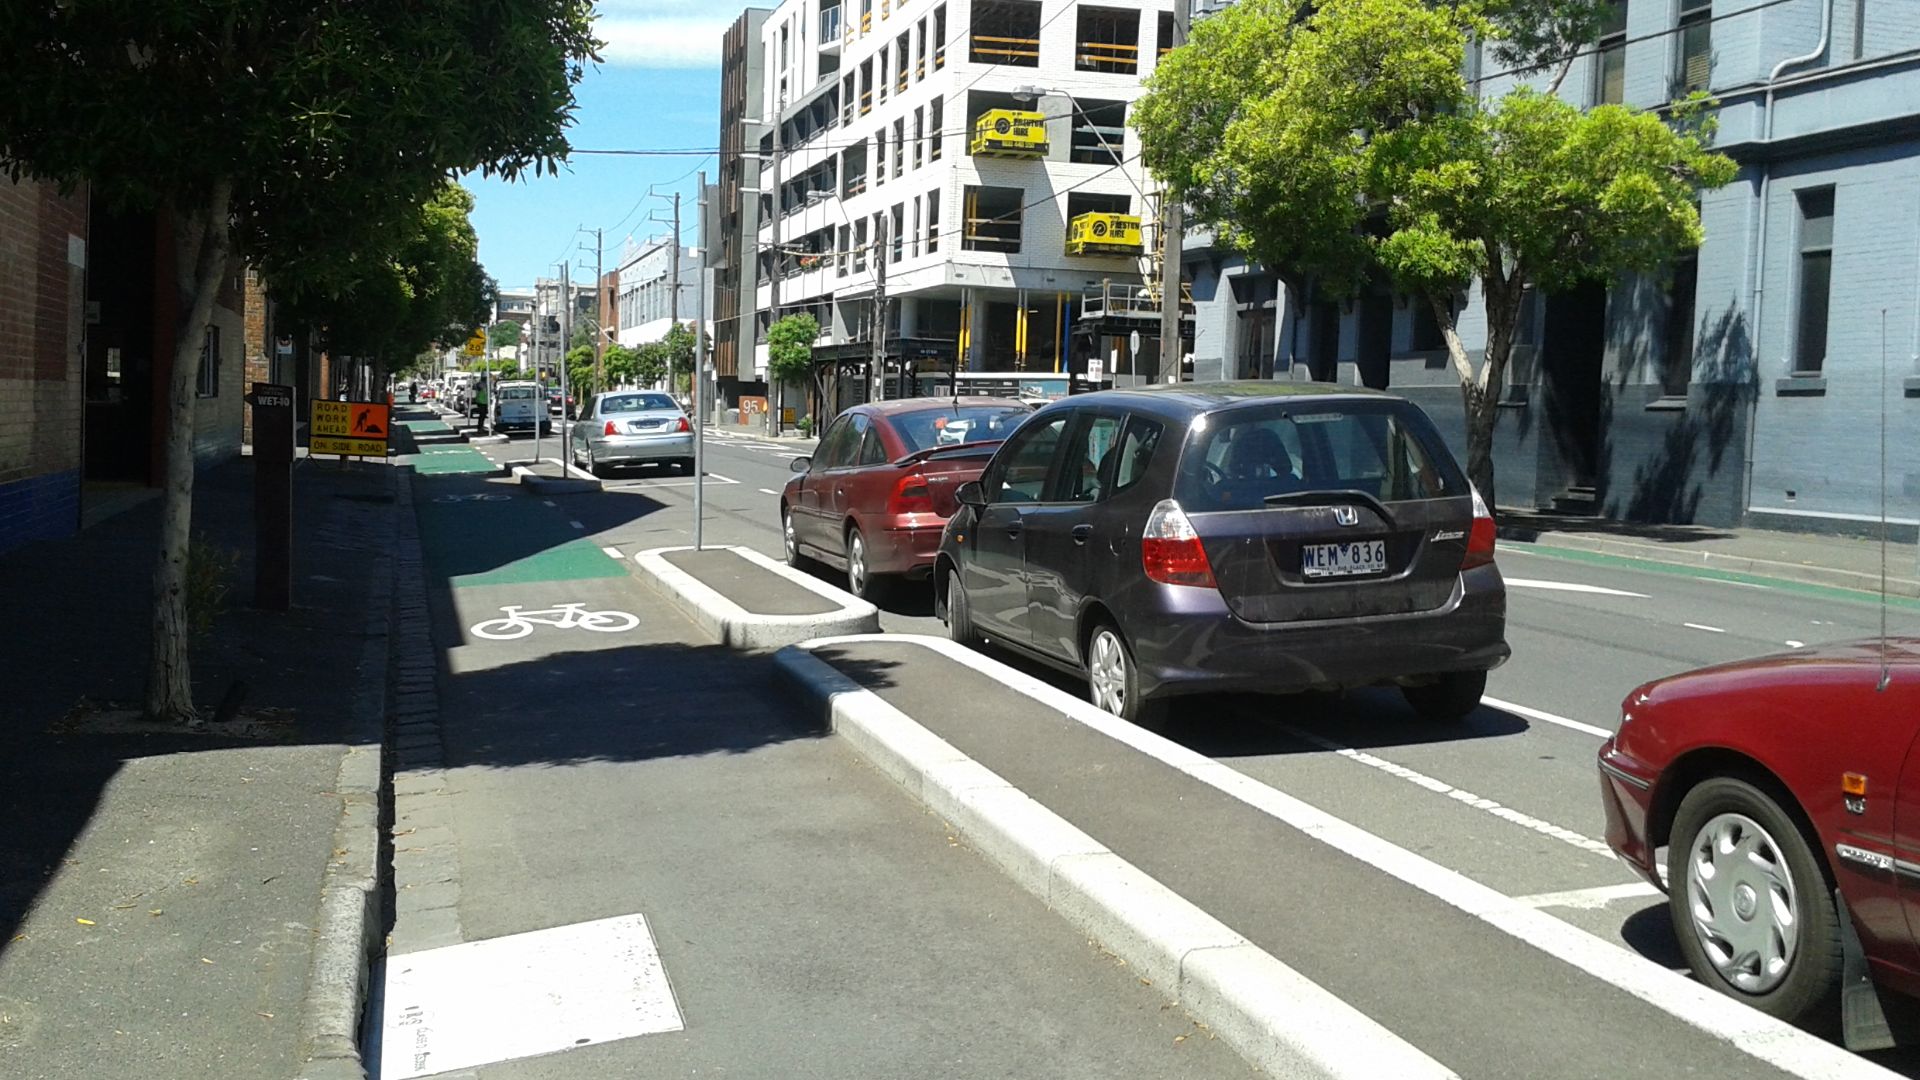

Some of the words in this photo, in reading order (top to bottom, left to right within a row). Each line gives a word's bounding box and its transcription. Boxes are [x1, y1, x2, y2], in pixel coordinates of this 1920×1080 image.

[317, 403, 347, 412] ROAD
[743, 400, 758, 414] 95
[317, 414, 347, 423] WORK
[317, 424, 347, 433] AHEAD
[314, 440, 327, 449] ON
[332, 442, 351, 451] SIDE
[358, 443, 383, 452] ROAD
[1304, 546, 1338, 567] WEM
[1352, 543, 1384, 564] 836
